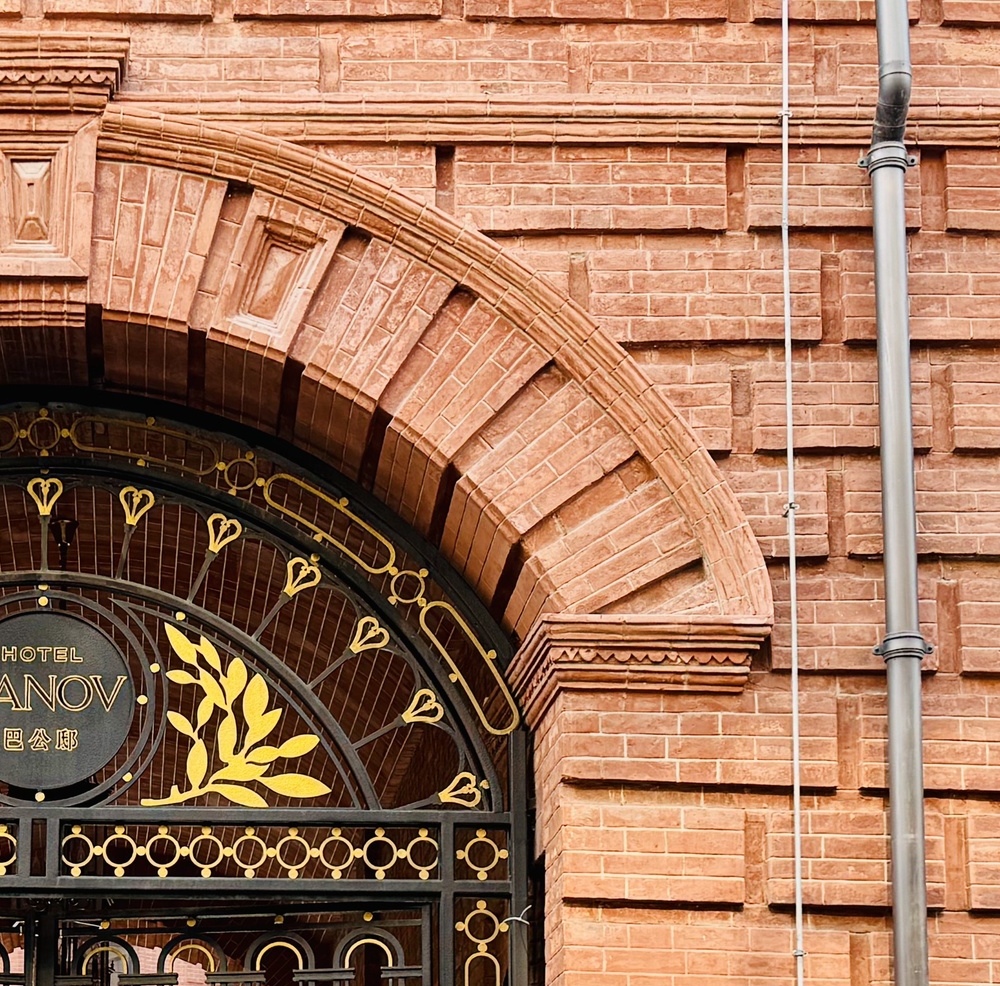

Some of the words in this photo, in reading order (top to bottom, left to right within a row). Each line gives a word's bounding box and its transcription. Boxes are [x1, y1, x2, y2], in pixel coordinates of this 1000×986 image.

[1, 646, 83, 663] HOTEL
[3, 728, 79, 752] 巴公邸
